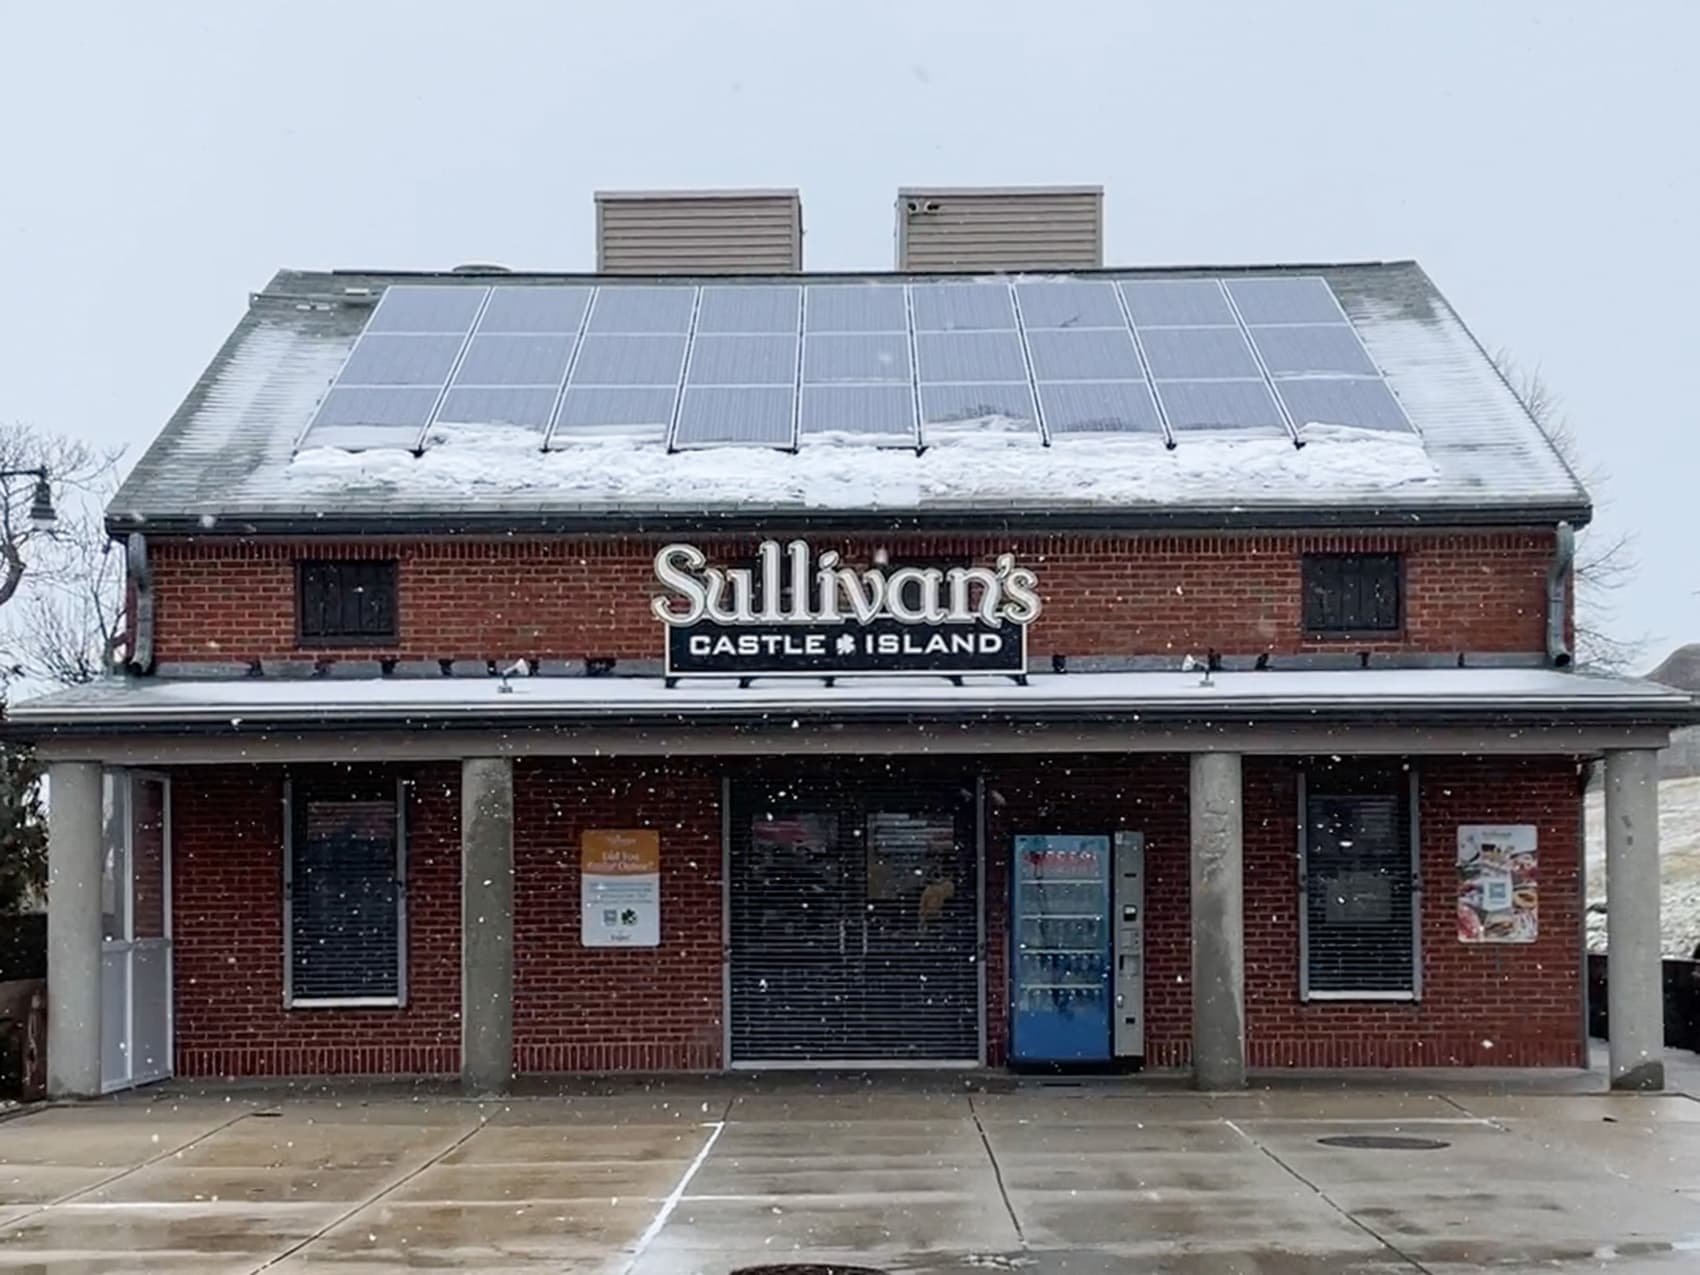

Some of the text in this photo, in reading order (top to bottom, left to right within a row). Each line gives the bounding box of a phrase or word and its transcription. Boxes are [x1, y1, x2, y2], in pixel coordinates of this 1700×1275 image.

[652, 539, 1042, 627] Sullivan's
[689, 633, 1003, 656] CASTLE ISLAND
